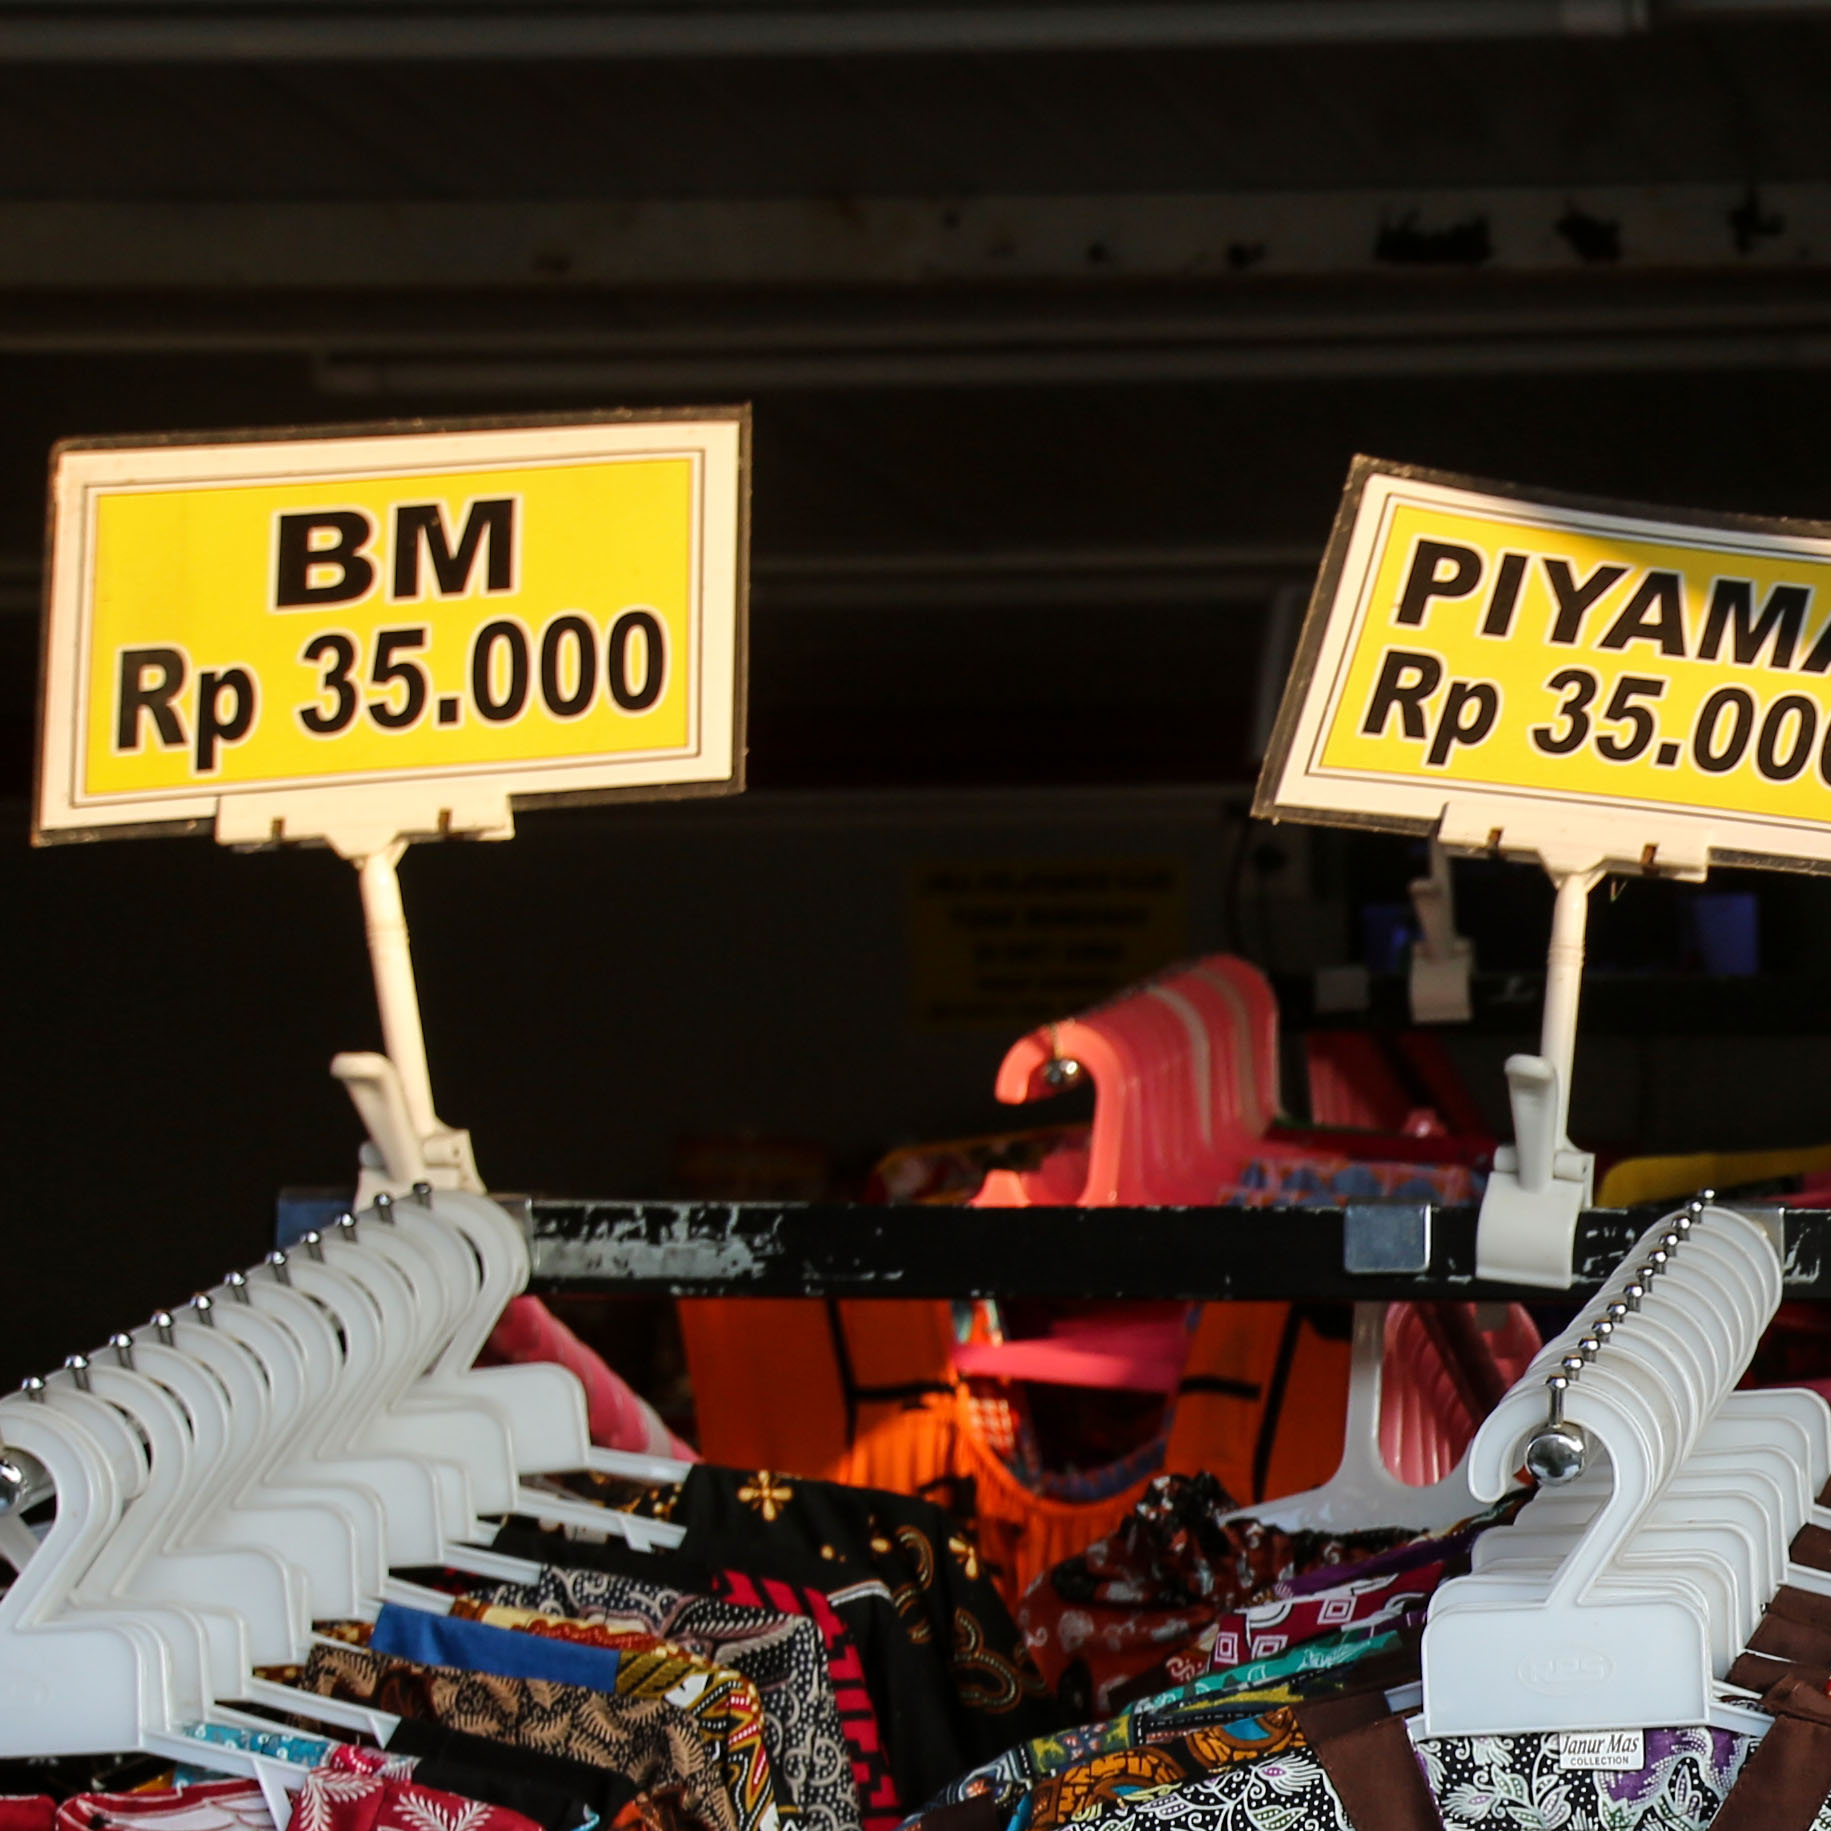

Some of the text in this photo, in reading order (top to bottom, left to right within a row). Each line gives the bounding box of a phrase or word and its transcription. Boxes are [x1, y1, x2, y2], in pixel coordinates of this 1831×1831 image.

[275, 498, 517, 609] BM
[116, 611, 664, 772] Rp 35.000
[1362, 650, 1499, 766] Rp
[1560, 1733, 1640, 1756] Janur Mas
[1570, 1755, 1629, 1766] COLLECTION
